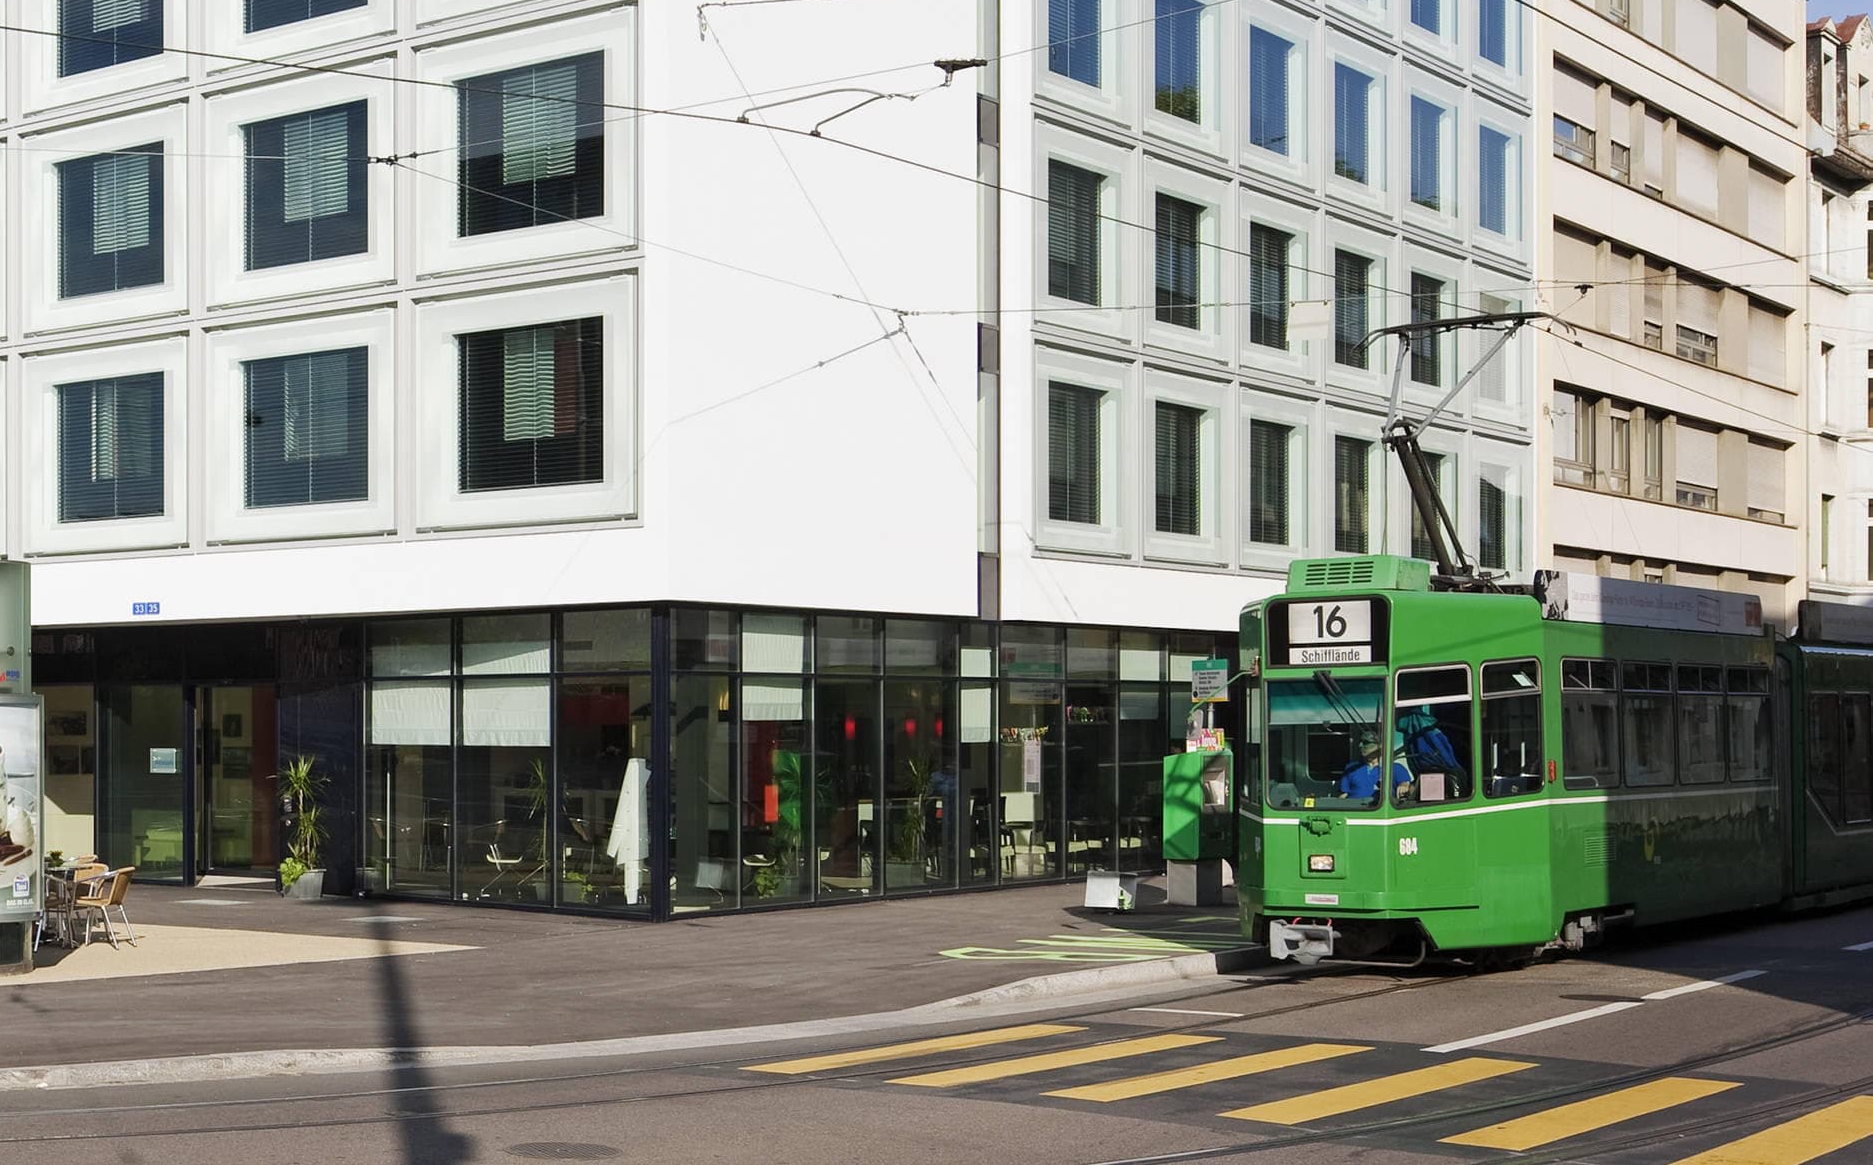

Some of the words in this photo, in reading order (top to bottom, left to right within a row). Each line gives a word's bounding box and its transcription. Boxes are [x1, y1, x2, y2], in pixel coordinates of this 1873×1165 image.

[1313, 605, 1347, 638] 16
[1301, 648, 1360, 663] Schifflände
[1399, 837, 1418, 855] 684
